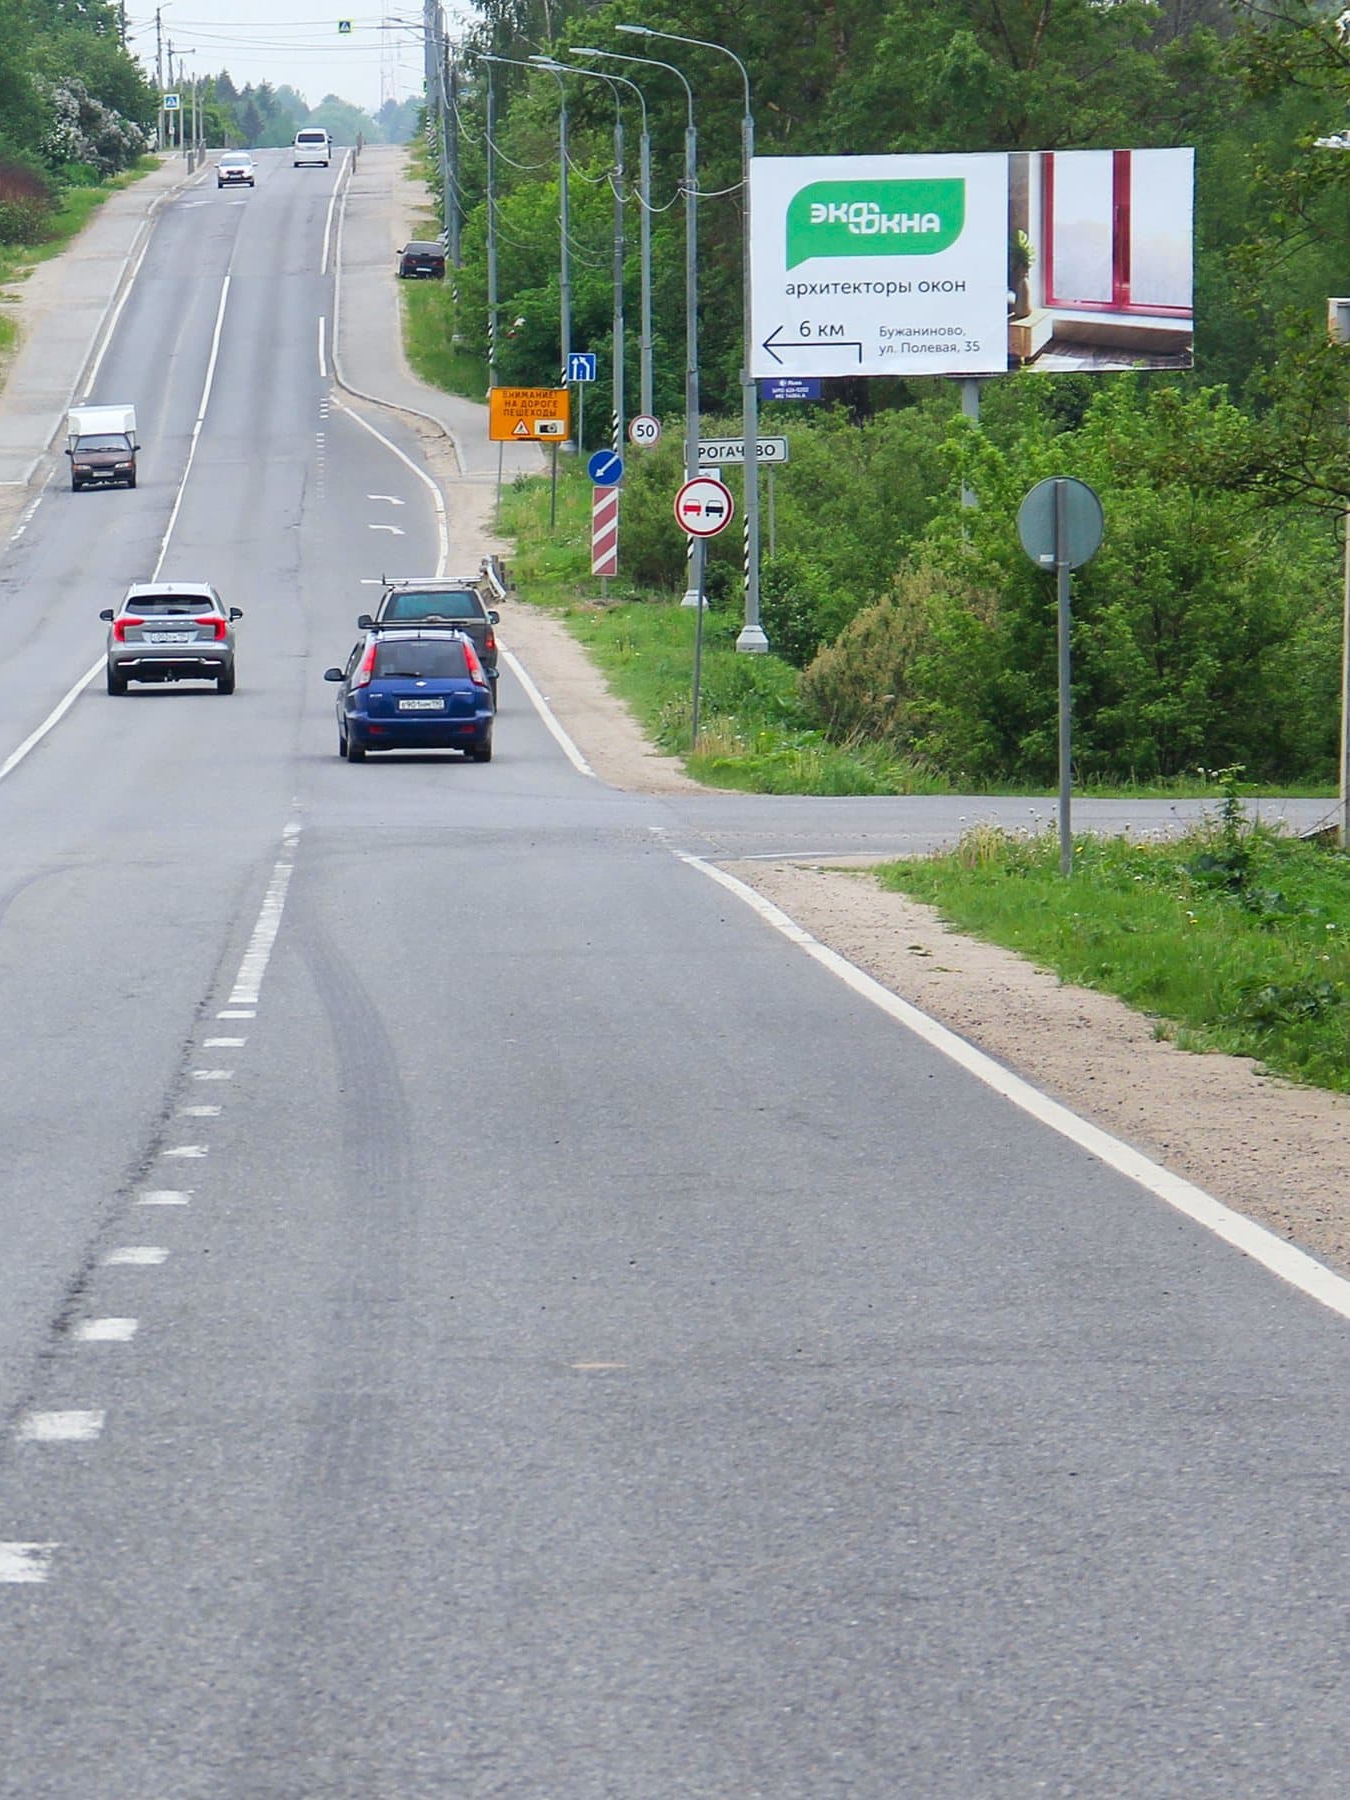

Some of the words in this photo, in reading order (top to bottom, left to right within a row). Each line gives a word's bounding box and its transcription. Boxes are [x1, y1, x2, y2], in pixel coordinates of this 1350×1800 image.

[786, 281, 912, 298] архитекторы
[918, 280, 966, 293] окон
[799, 320, 811, 337] 6
[818, 324, 845, 337] км
[879, 326, 966, 338] Бужаниново,
[879, 344, 896, 356] ул.
[901, 341, 960, 354] Полевая,
[964, 341, 980, 352] 35
[505, 400, 517, 408] НА
[521, 400, 559, 408] ДОРОГЕ
[503, 408, 557, 417] ПЕШЕХОДЫ
[637, 424, 655, 438] 50
[698, 444, 776, 459] РОГАЧВО
